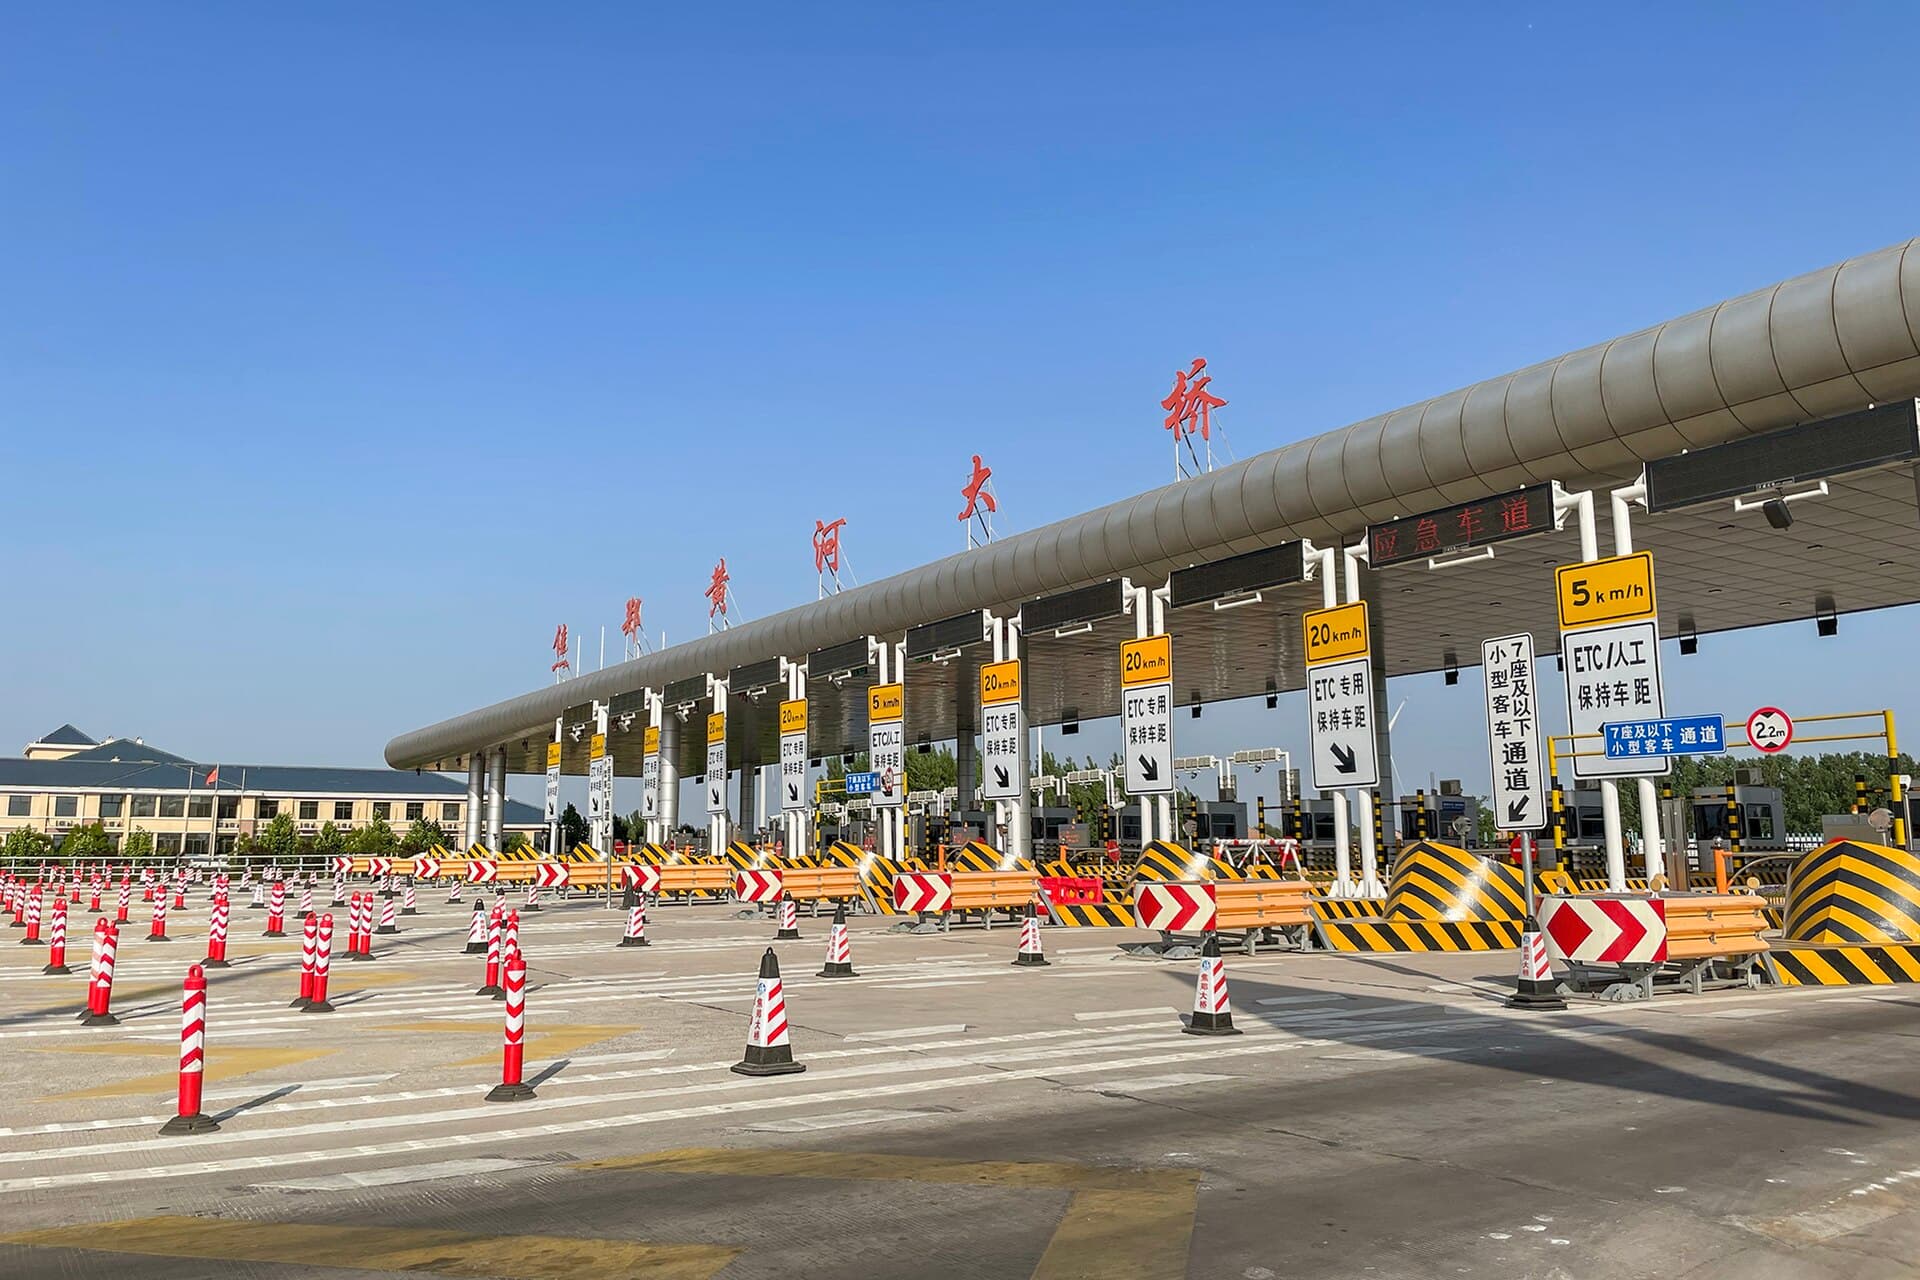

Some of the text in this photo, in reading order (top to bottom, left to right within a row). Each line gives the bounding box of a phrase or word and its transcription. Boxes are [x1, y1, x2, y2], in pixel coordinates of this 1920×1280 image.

[1375, 494, 1532, 560] 应急车道
[1571, 579, 1644, 607] 5 km/h
[1310, 623, 1362, 647] 20 km/h
[1125, 651, 1166, 672] 20 km/h
[1573, 640, 1646, 673] ETC/人工
[984, 674, 998, 692] 20
[1314, 672, 1364, 702] ETC 专用
[1489, 645, 1512, 739] 小型客车
[1510, 641, 1532, 737] 7座及以下
[1577, 677, 1652, 711] 保持车距
[872, 694, 880, 710] 5
[1127, 694, 1167, 719] ETC 专用
[782, 709, 791, 724] 20
[986, 712, 1017, 733] ETC 专用
[1317, 705, 1367, 733] 保持车距
[1129, 723, 1167, 745] 保持车距
[1610, 723, 1673, 740] 7座及以下
[1679, 725, 1718, 745] 通道
[1611, 737, 1675, 755] 小型客车
[1502, 741, 1530, 791] 通道
